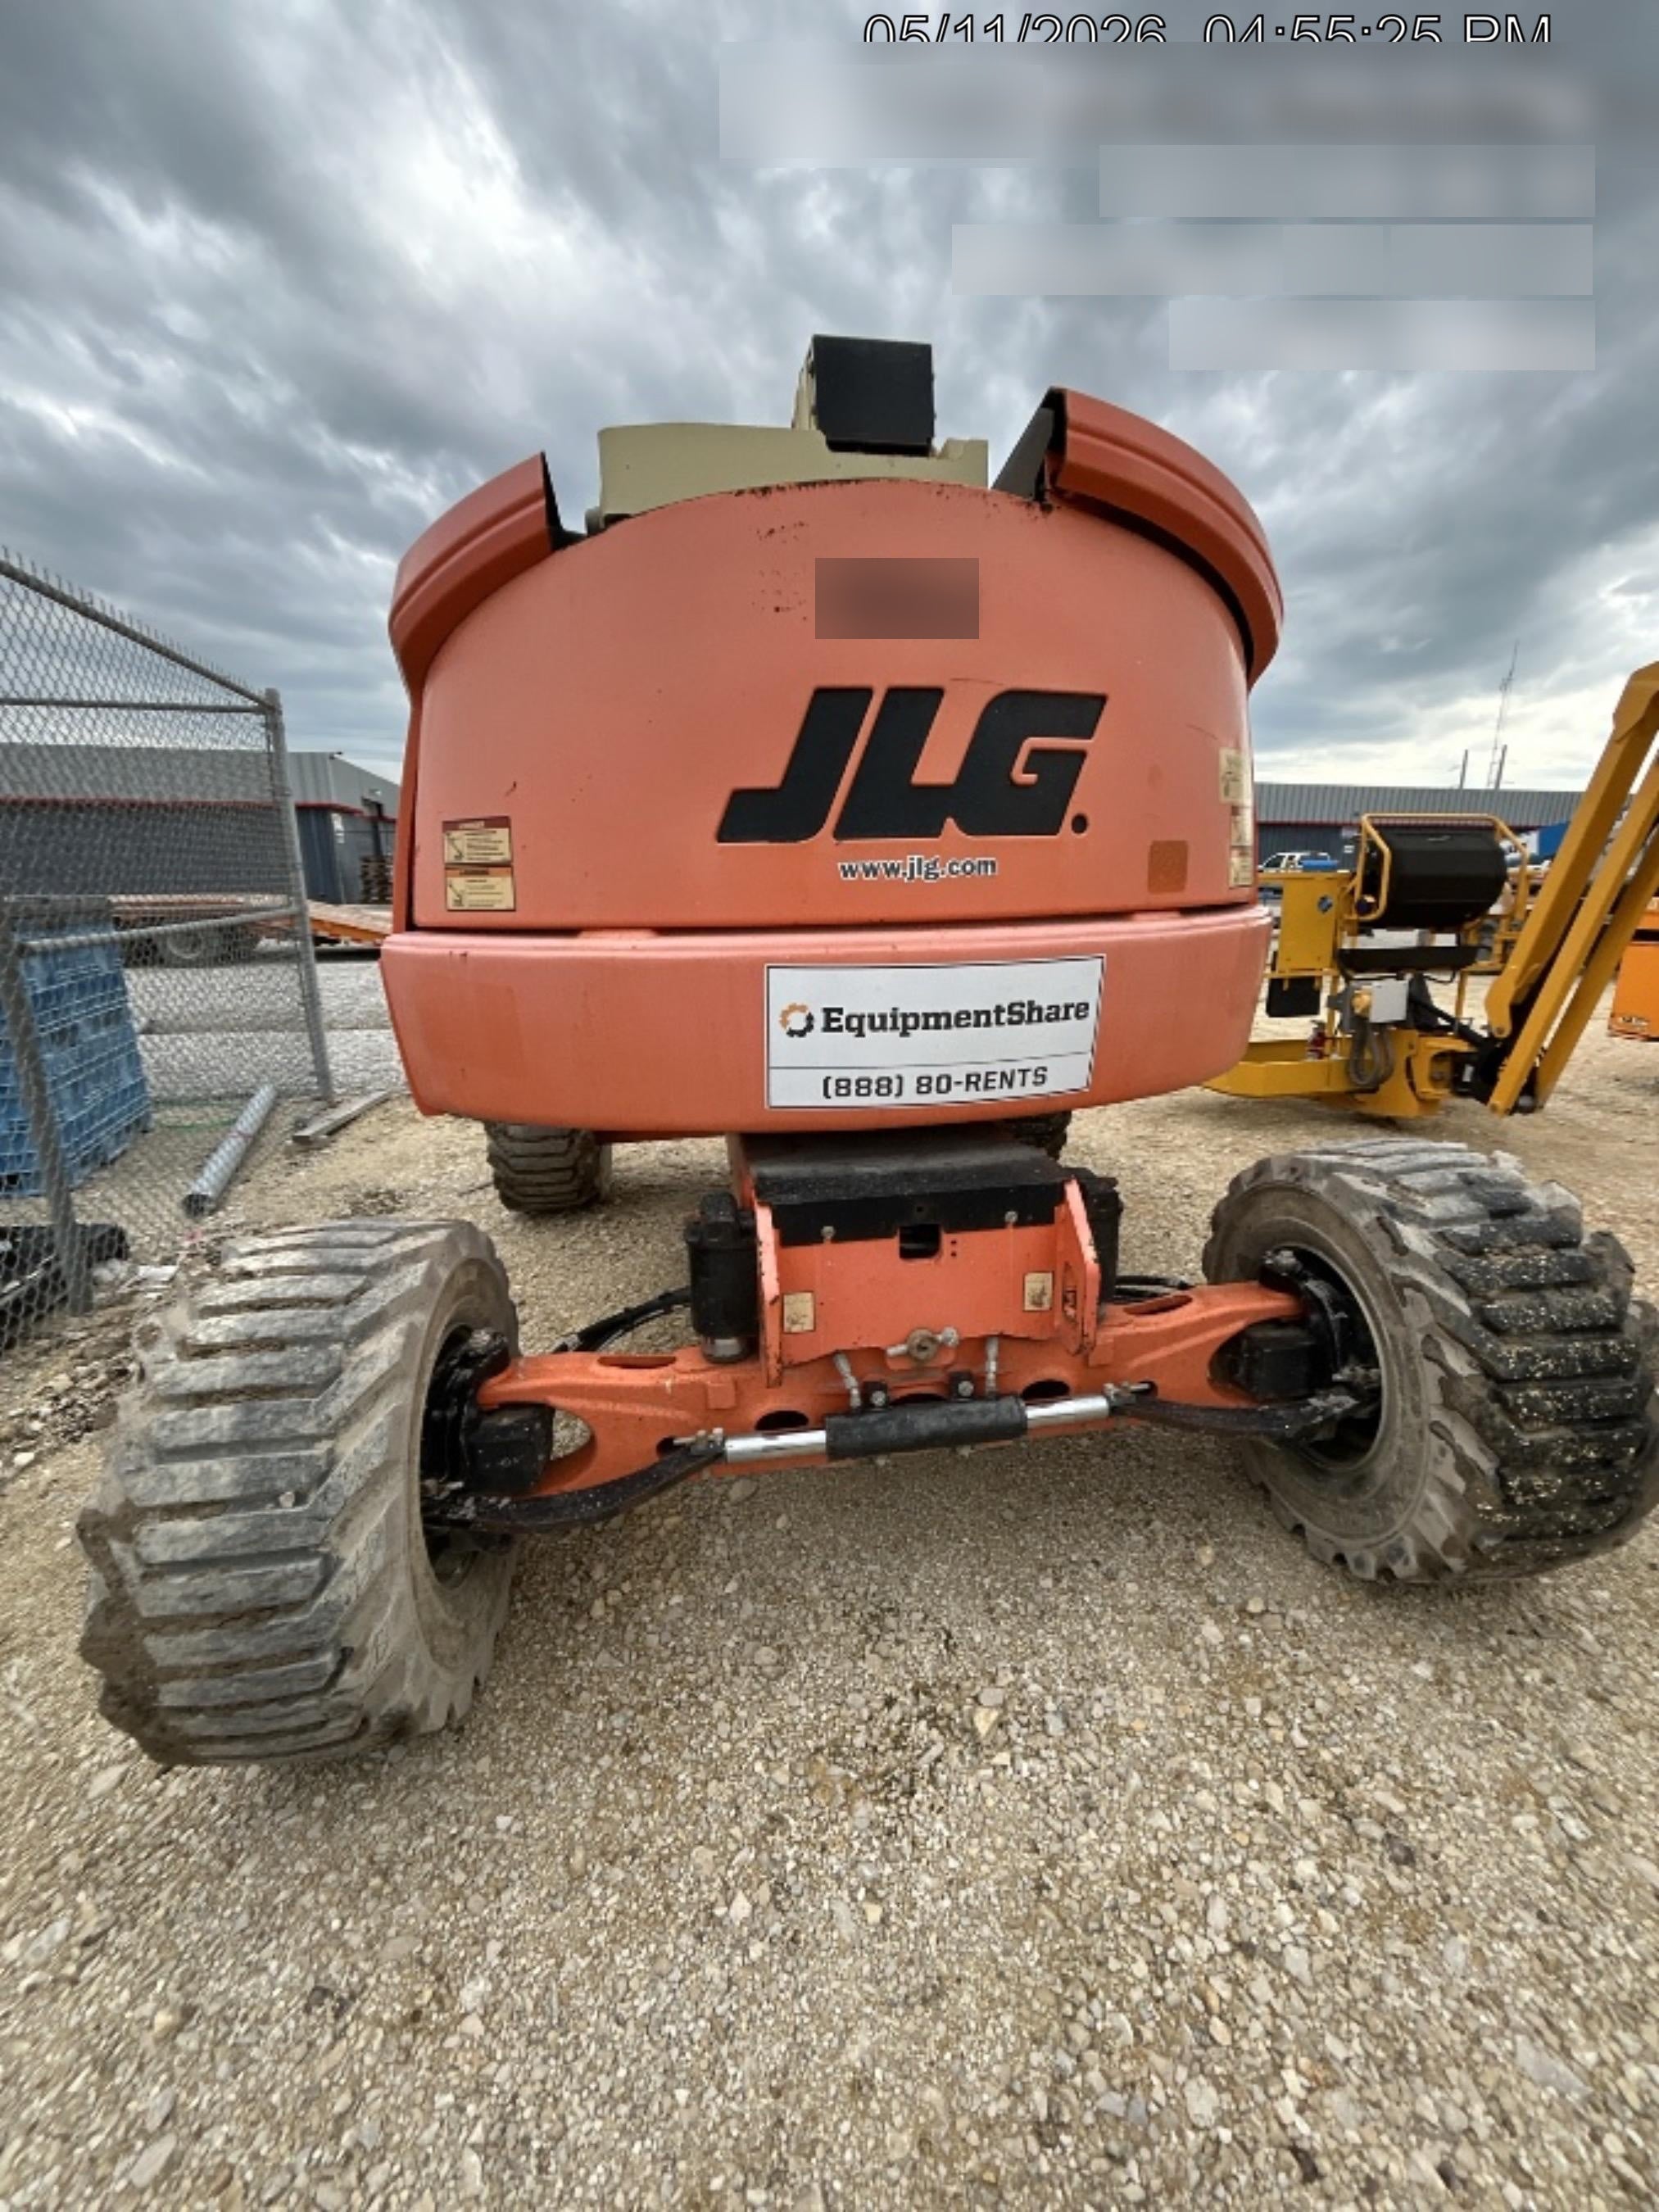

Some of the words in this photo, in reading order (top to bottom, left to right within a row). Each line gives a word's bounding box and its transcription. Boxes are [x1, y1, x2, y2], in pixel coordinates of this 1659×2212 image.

[838, 855, 998, 882] www.jlg.com
[821, 1000, 1090, 1037] EquipmentShare
[823, 1074, 904, 1099] (888)
[915, 1066, 1048, 1095] 80-RENTS
